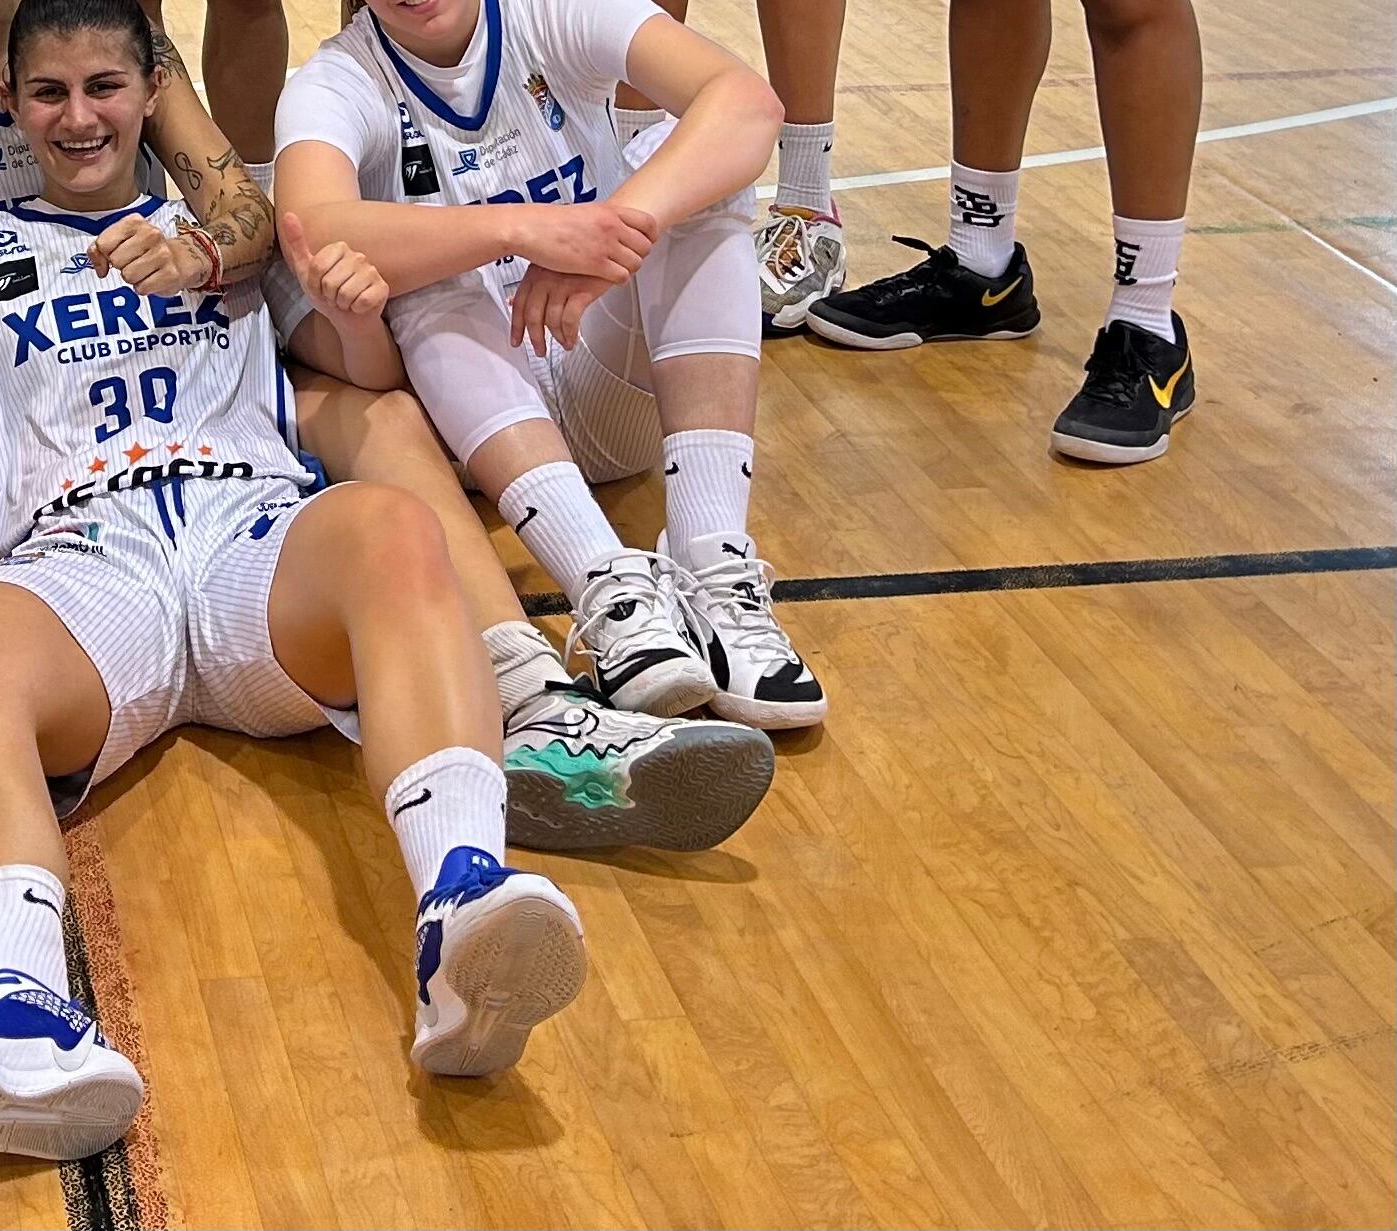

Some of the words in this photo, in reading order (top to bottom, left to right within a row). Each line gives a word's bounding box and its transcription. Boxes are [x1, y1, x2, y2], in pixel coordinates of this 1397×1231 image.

[11, 159, 24, 169] de
[484, 156, 496, 169] de
[57, 341, 112, 366] CLUB
[117, 326, 231, 355] DEPORTIVO
[88, 366, 178, 444] 30
